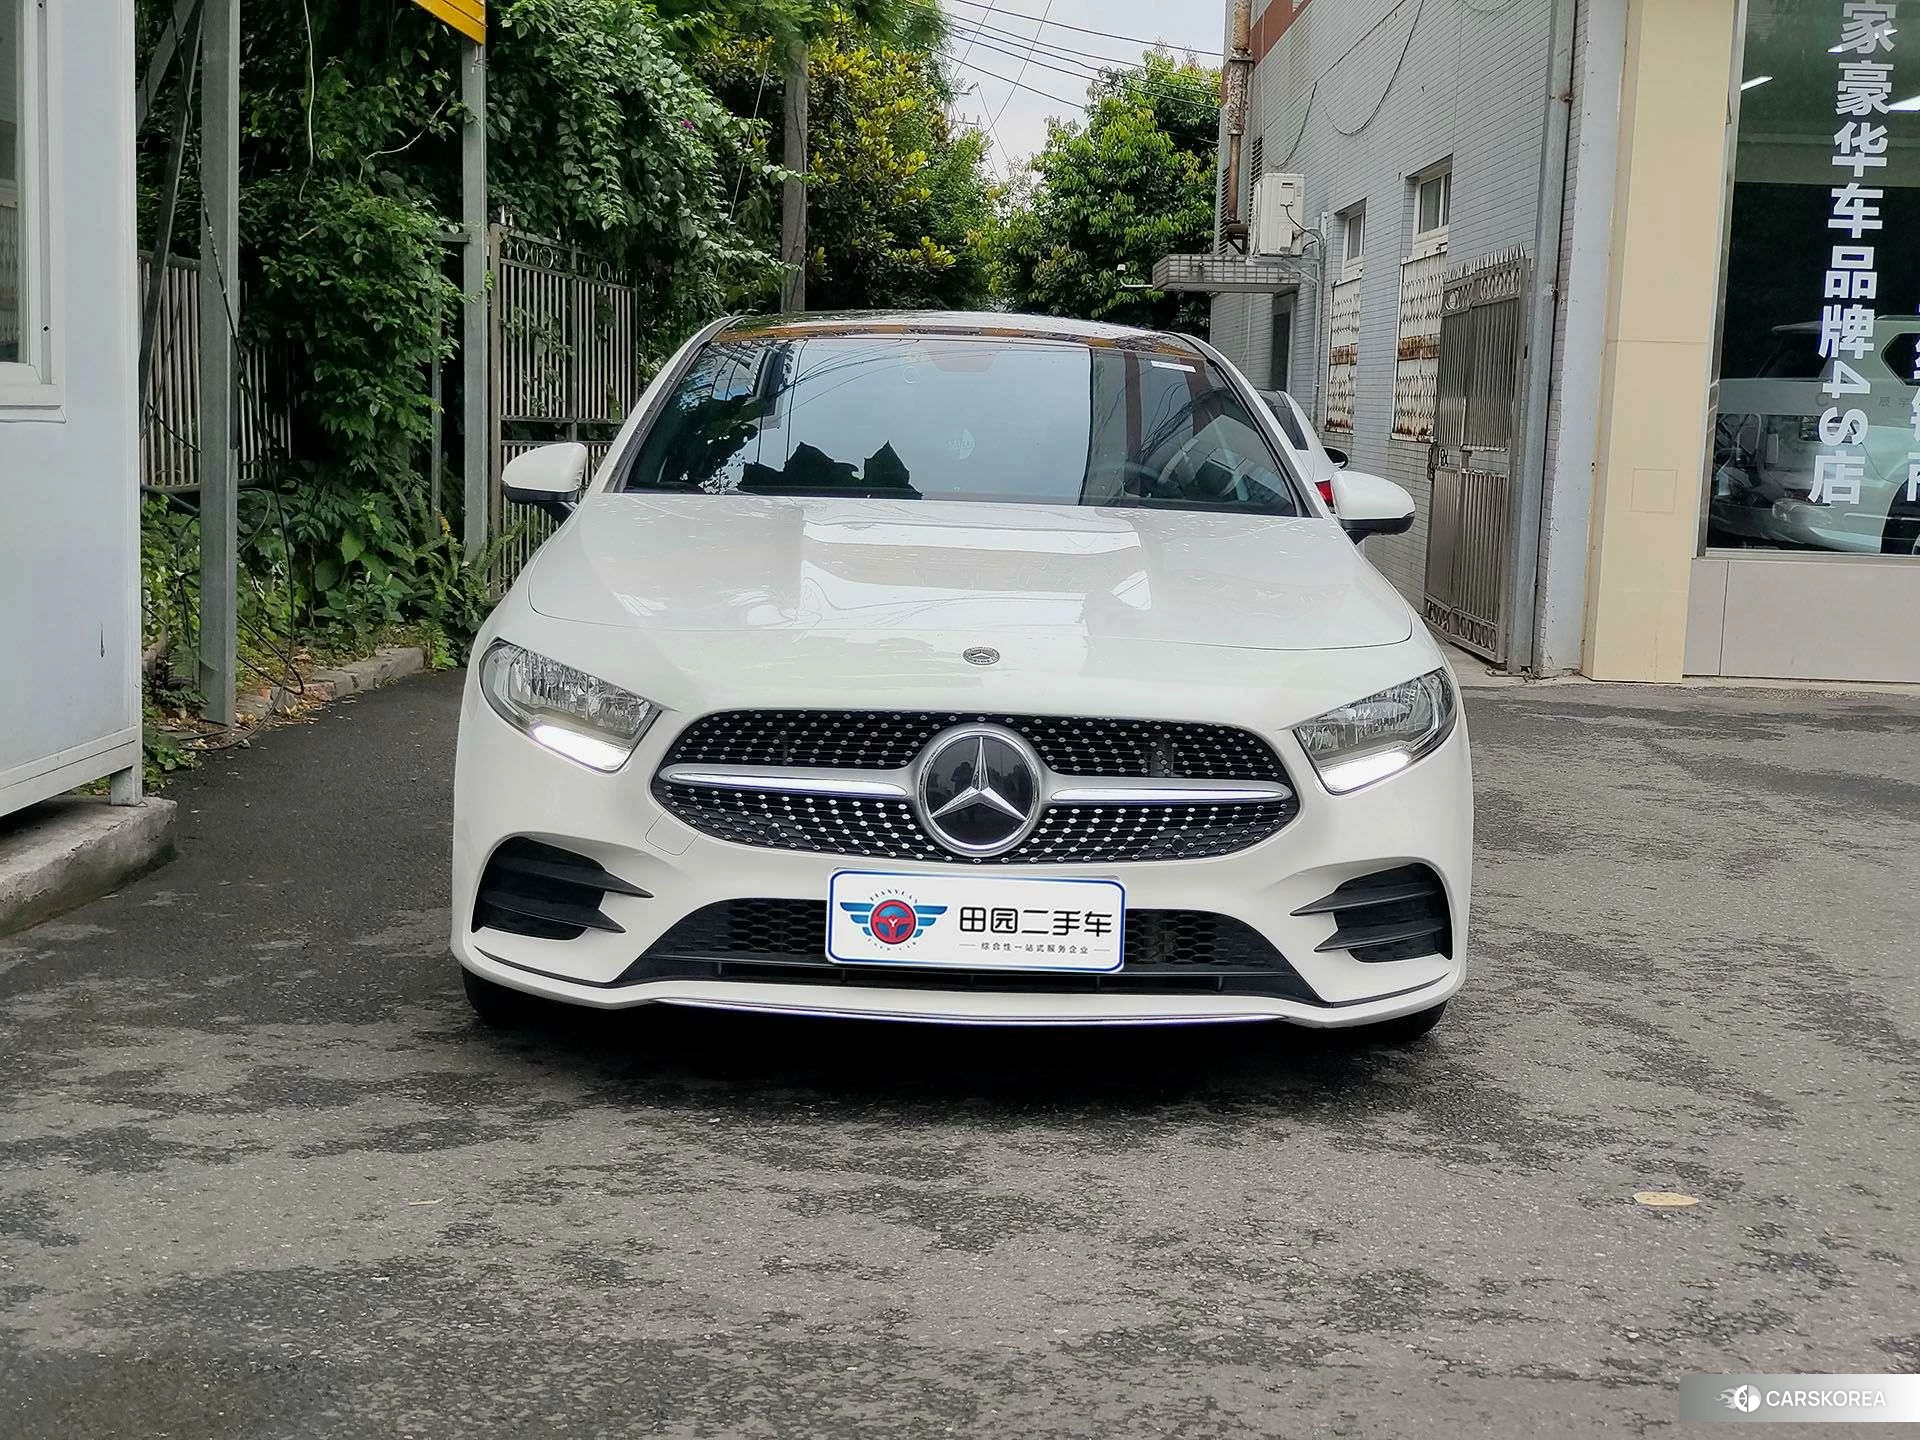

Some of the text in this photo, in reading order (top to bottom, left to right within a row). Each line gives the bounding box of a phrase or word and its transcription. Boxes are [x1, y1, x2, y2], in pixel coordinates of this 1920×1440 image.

[960, 907, 1113, 937] 田园二手车
[981, 942, 1088, 954] 综合性一站式服务企业
